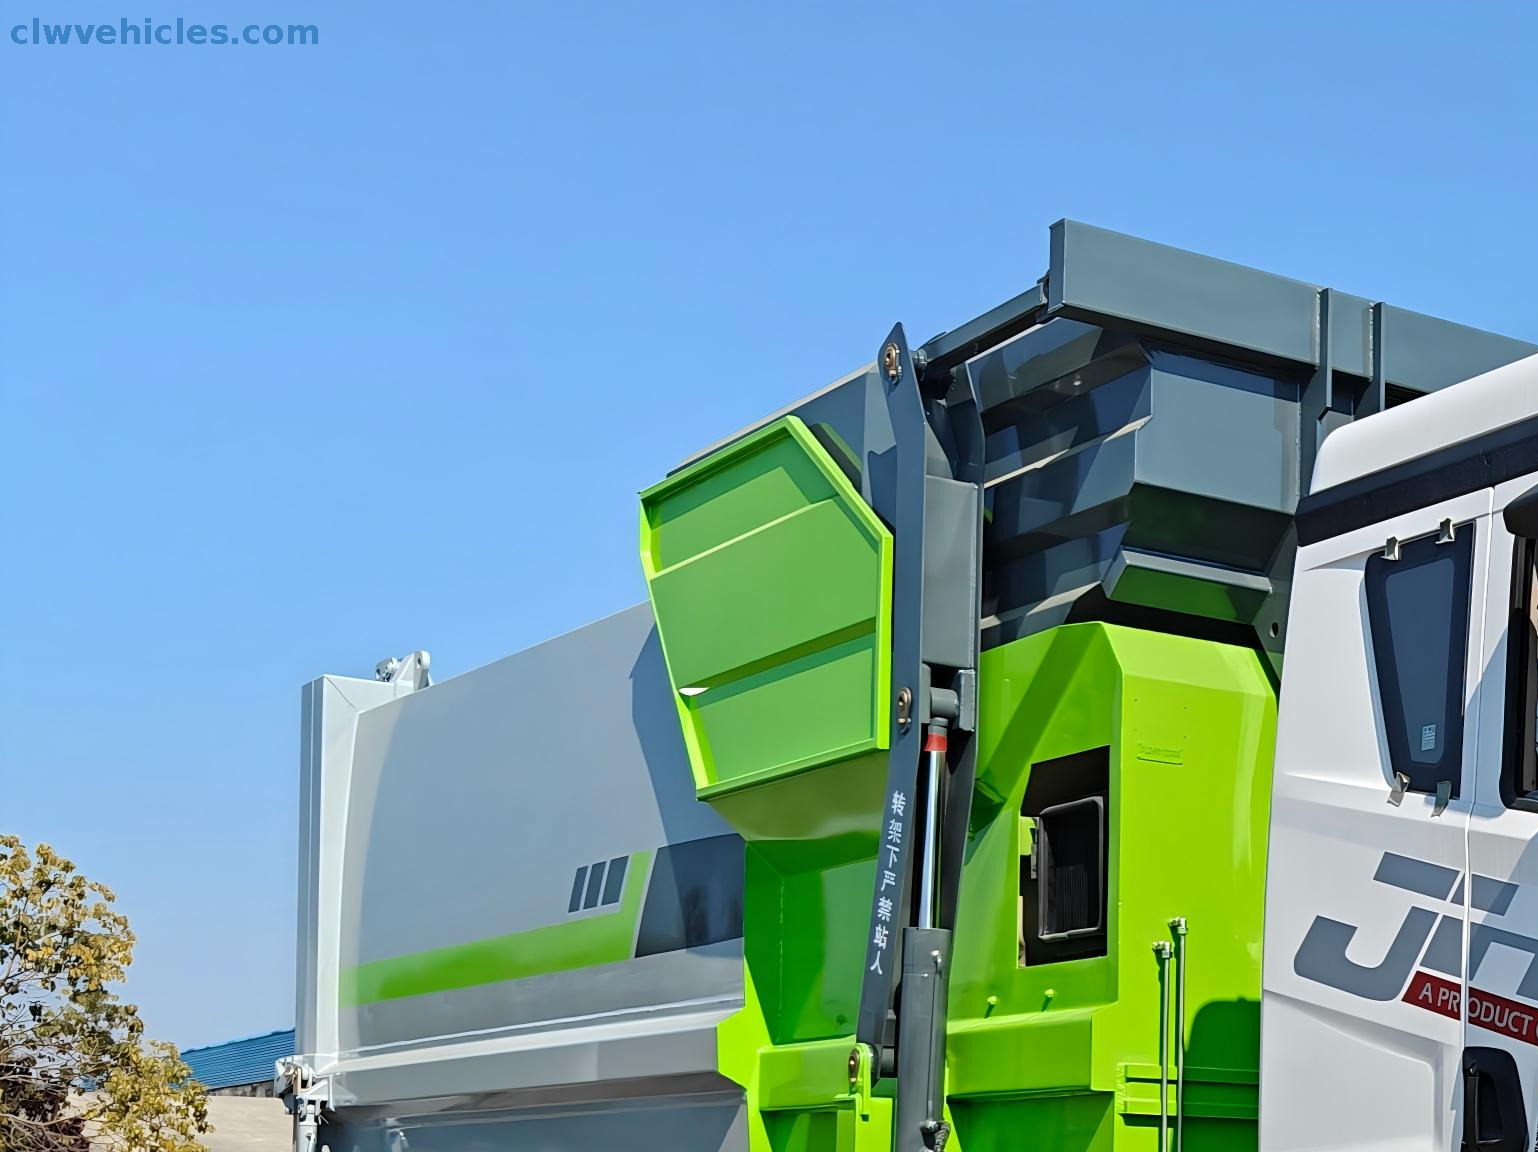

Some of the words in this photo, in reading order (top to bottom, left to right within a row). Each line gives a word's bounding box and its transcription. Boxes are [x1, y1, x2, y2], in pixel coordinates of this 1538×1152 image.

[871, 791, 906, 975] 转架下严禁站人
[1418, 982, 1433, 1004] A
[1437, 987, 1534, 1036] PRODUCT
